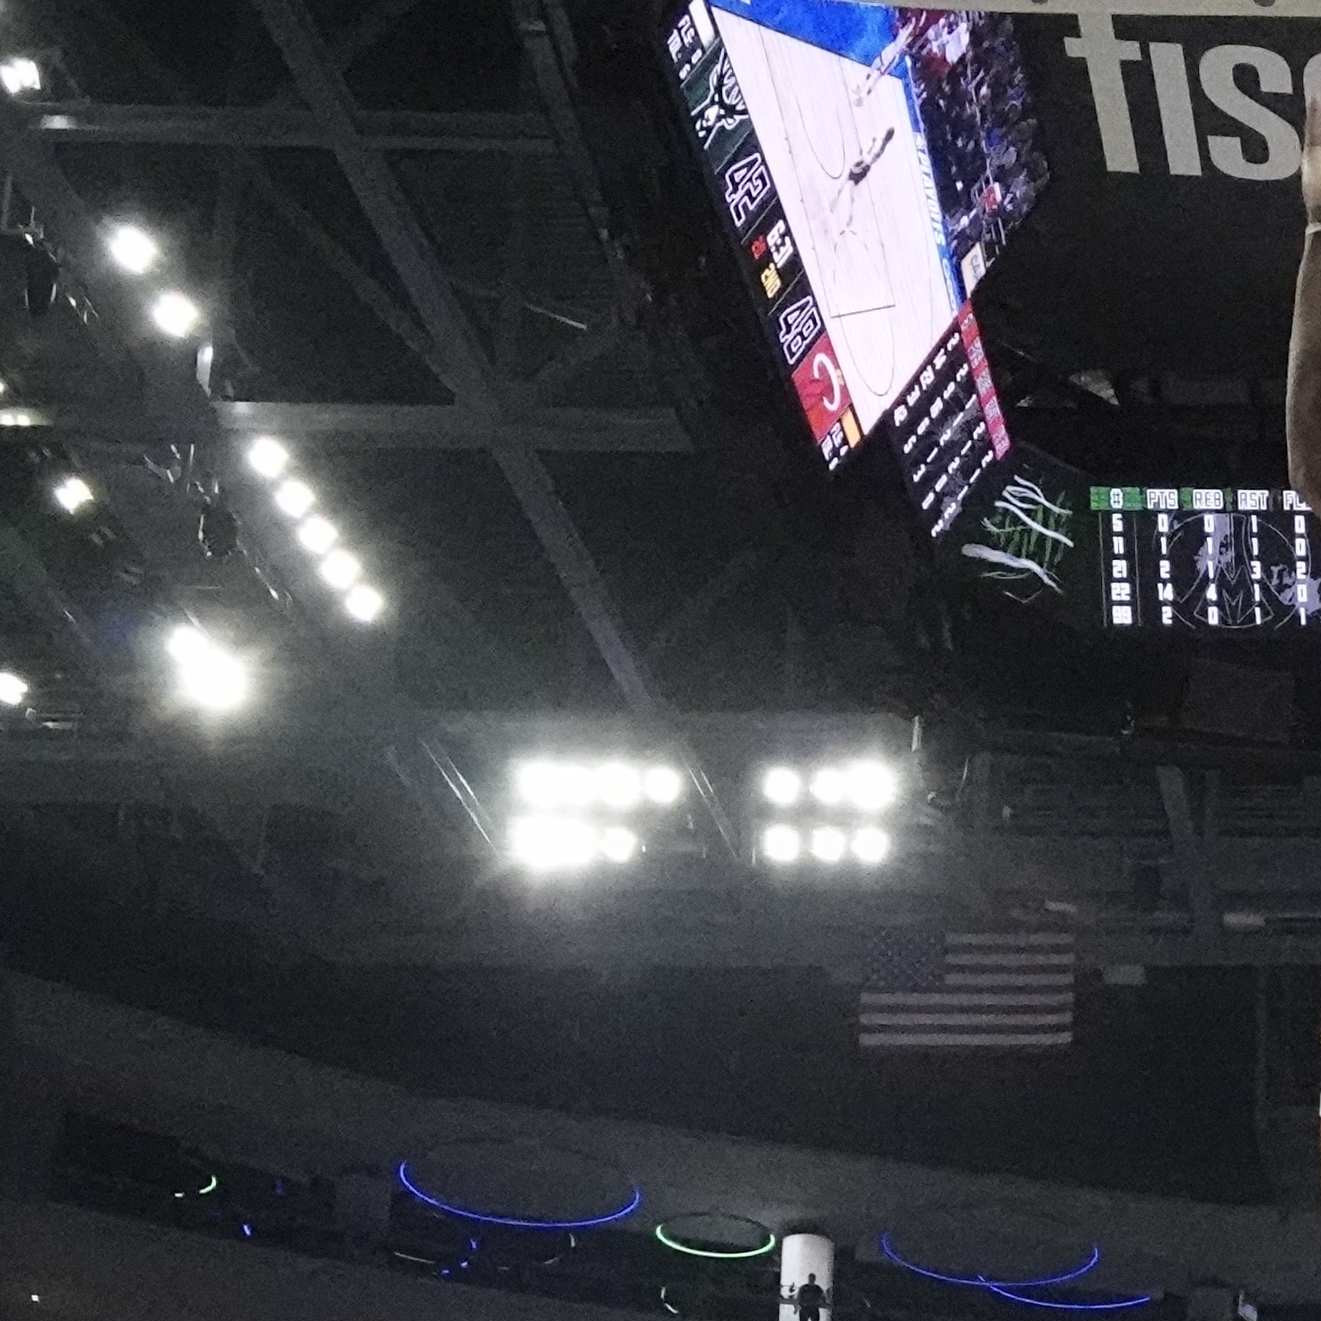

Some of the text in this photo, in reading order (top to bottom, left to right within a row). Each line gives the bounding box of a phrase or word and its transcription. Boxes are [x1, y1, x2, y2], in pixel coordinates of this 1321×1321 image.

[725, 152, 771, 227] 42
[779, 295, 822, 364] 48
[1146, 488, 1179, 510] PTS
[1192, 489, 1224, 510] REB
[1236, 489, 1269, 510] AST
[1282, 490, 1311, 510] FL
[1112, 513, 1123, 533] 5
[1112, 536, 1125, 555] 11
[1112, 560, 1127, 579] 21
[1111, 582, 1173, 601] 22 14
[1112, 605, 1132, 625] 99
